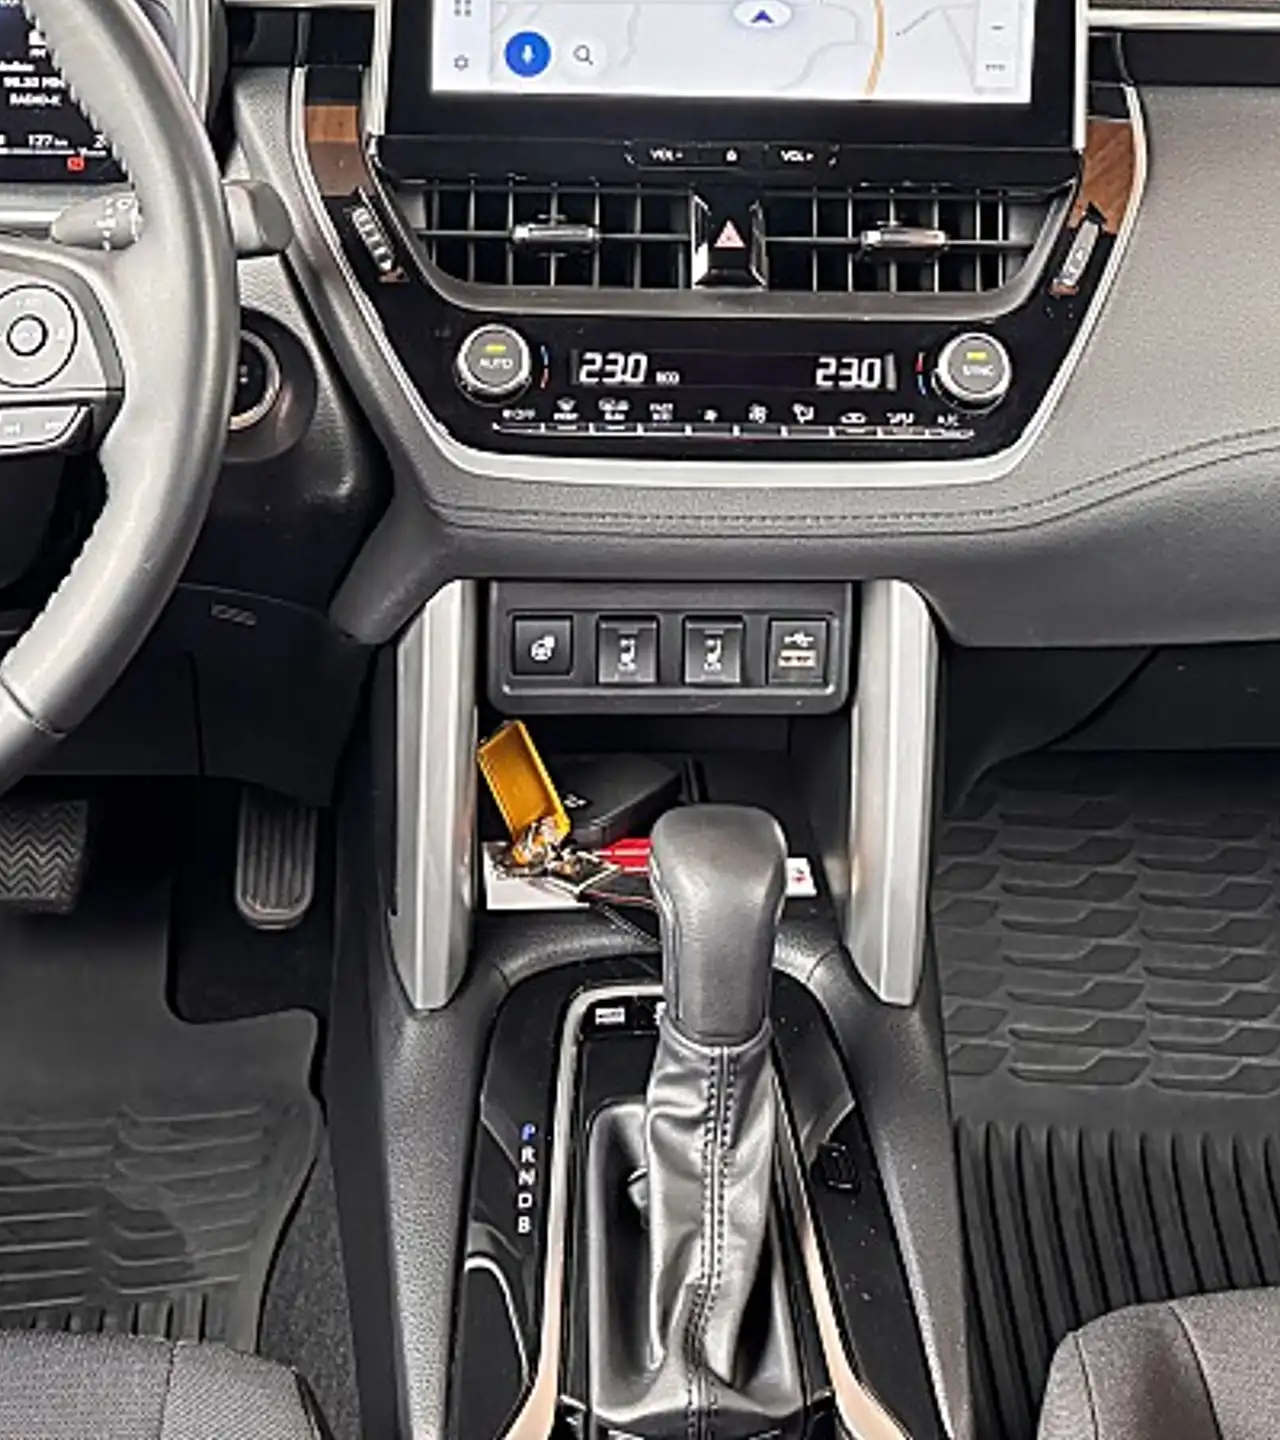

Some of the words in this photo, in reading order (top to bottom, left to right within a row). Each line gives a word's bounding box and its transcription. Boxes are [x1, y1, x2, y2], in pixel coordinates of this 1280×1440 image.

[478, 357, 513, 369] AUTO
[522, 1123, 536, 1140] P
[521, 1146, 536, 1163] R
[519, 1167, 536, 1185] N
[518, 1193, 533, 1209] D
[518, 1216, 532, 1234] B
